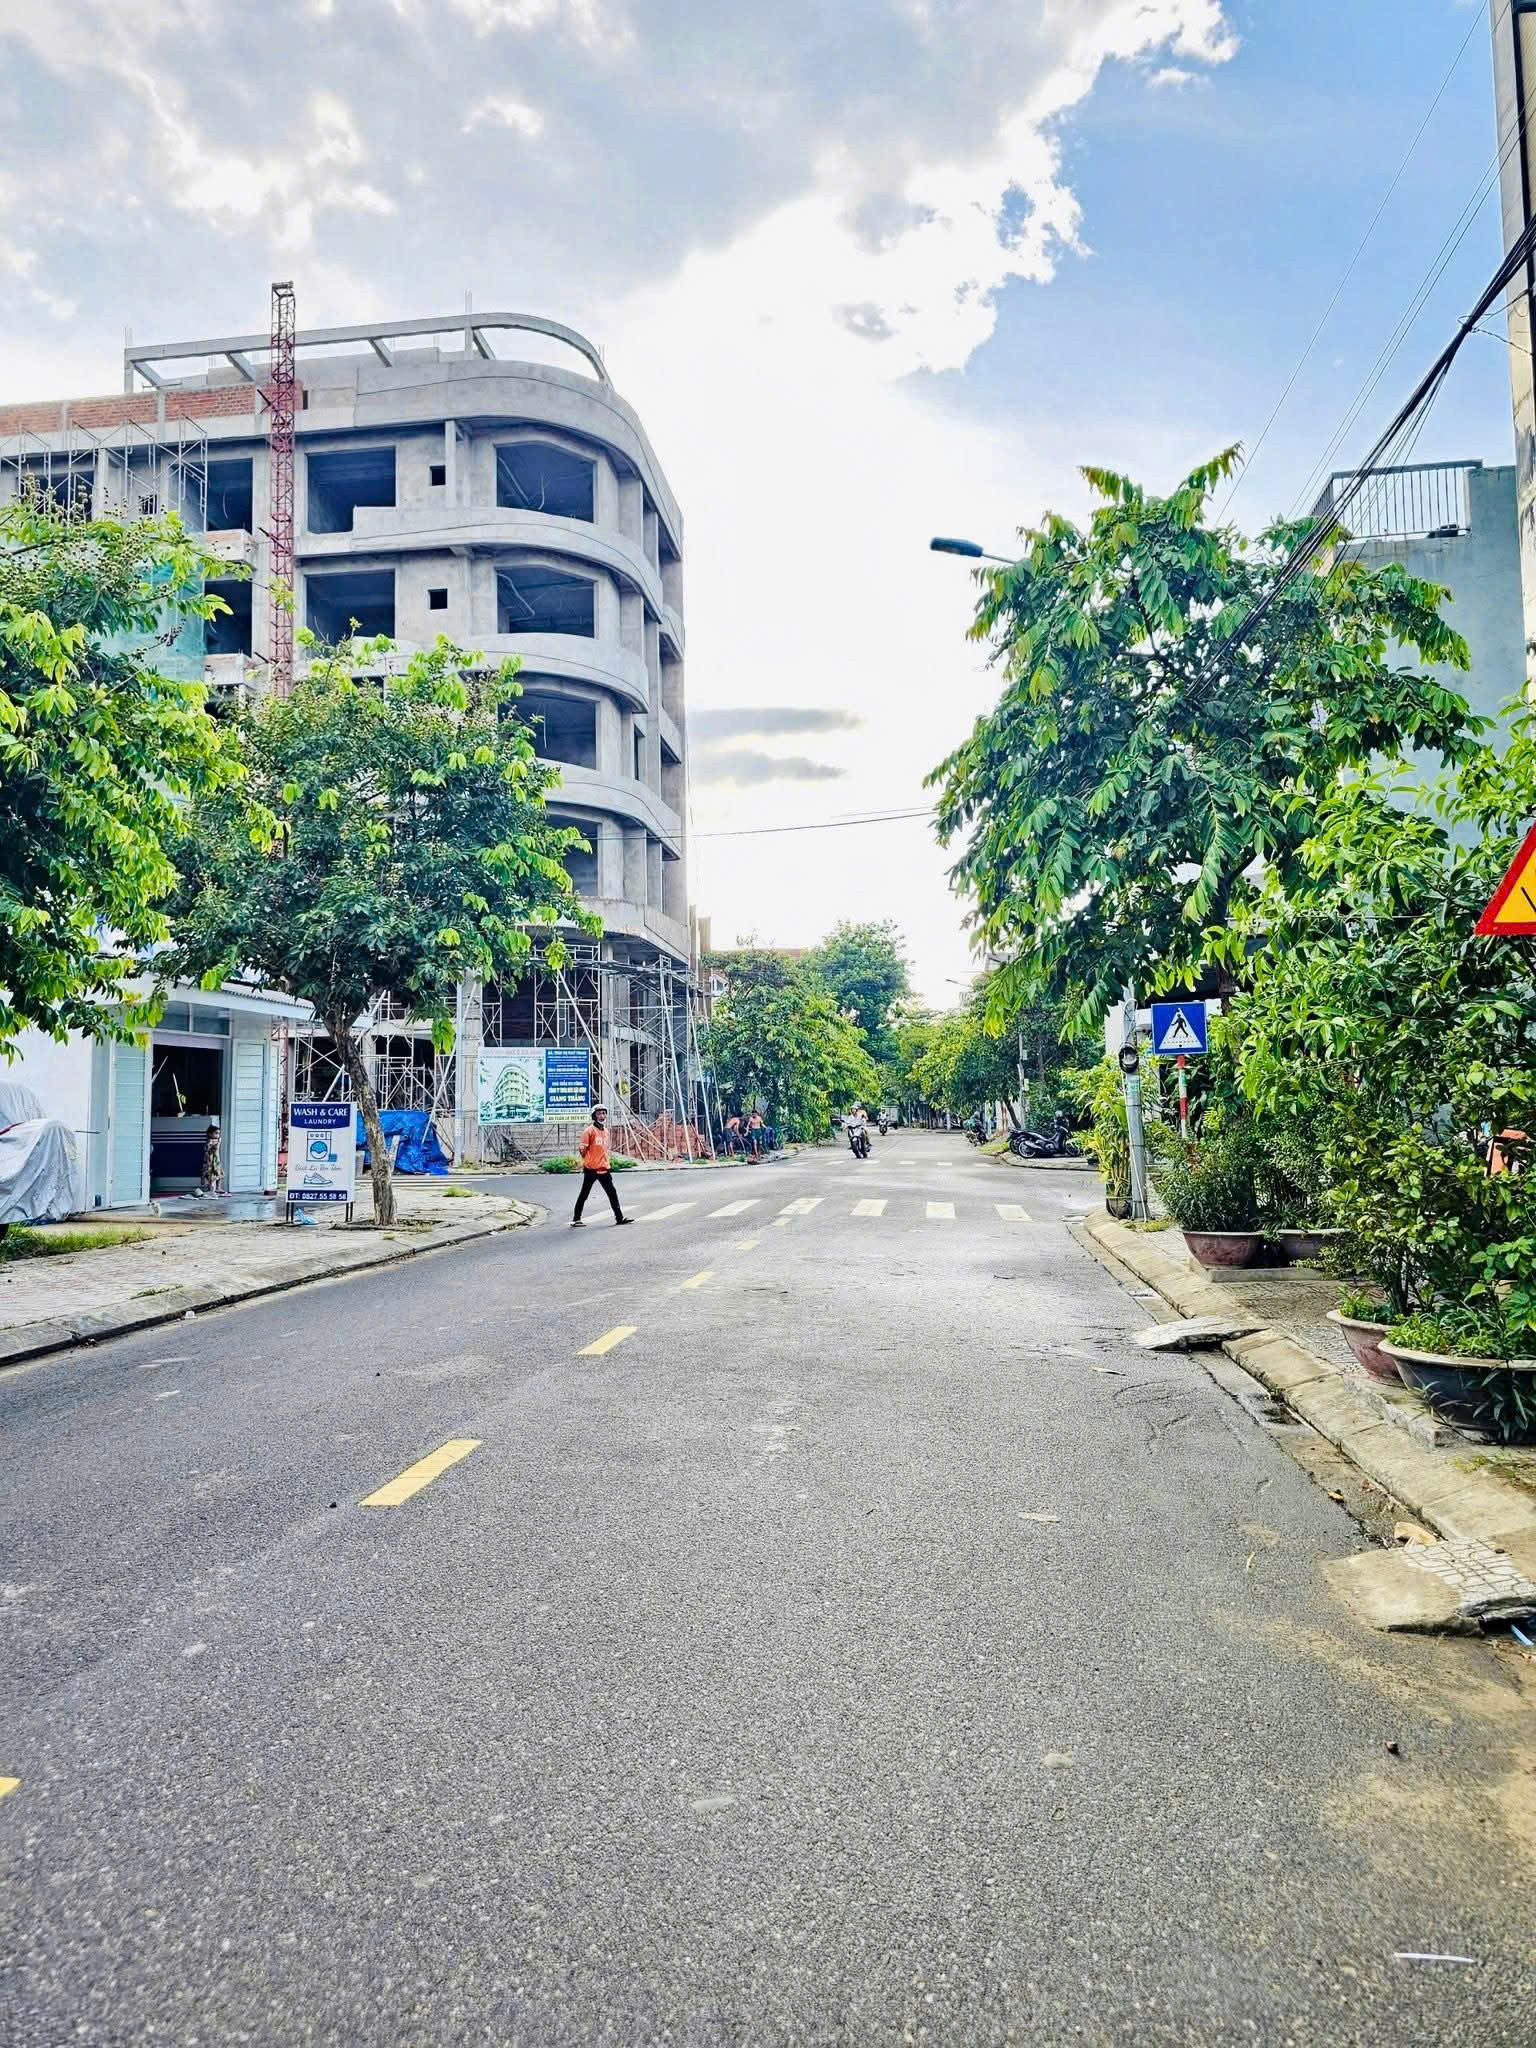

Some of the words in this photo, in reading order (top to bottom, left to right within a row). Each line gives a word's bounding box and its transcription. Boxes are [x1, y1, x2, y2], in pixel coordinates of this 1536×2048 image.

[293, 1108, 318, 1116] WASH
[319, 1108, 326, 1116] &
[327, 1108, 348, 1116] CARE
